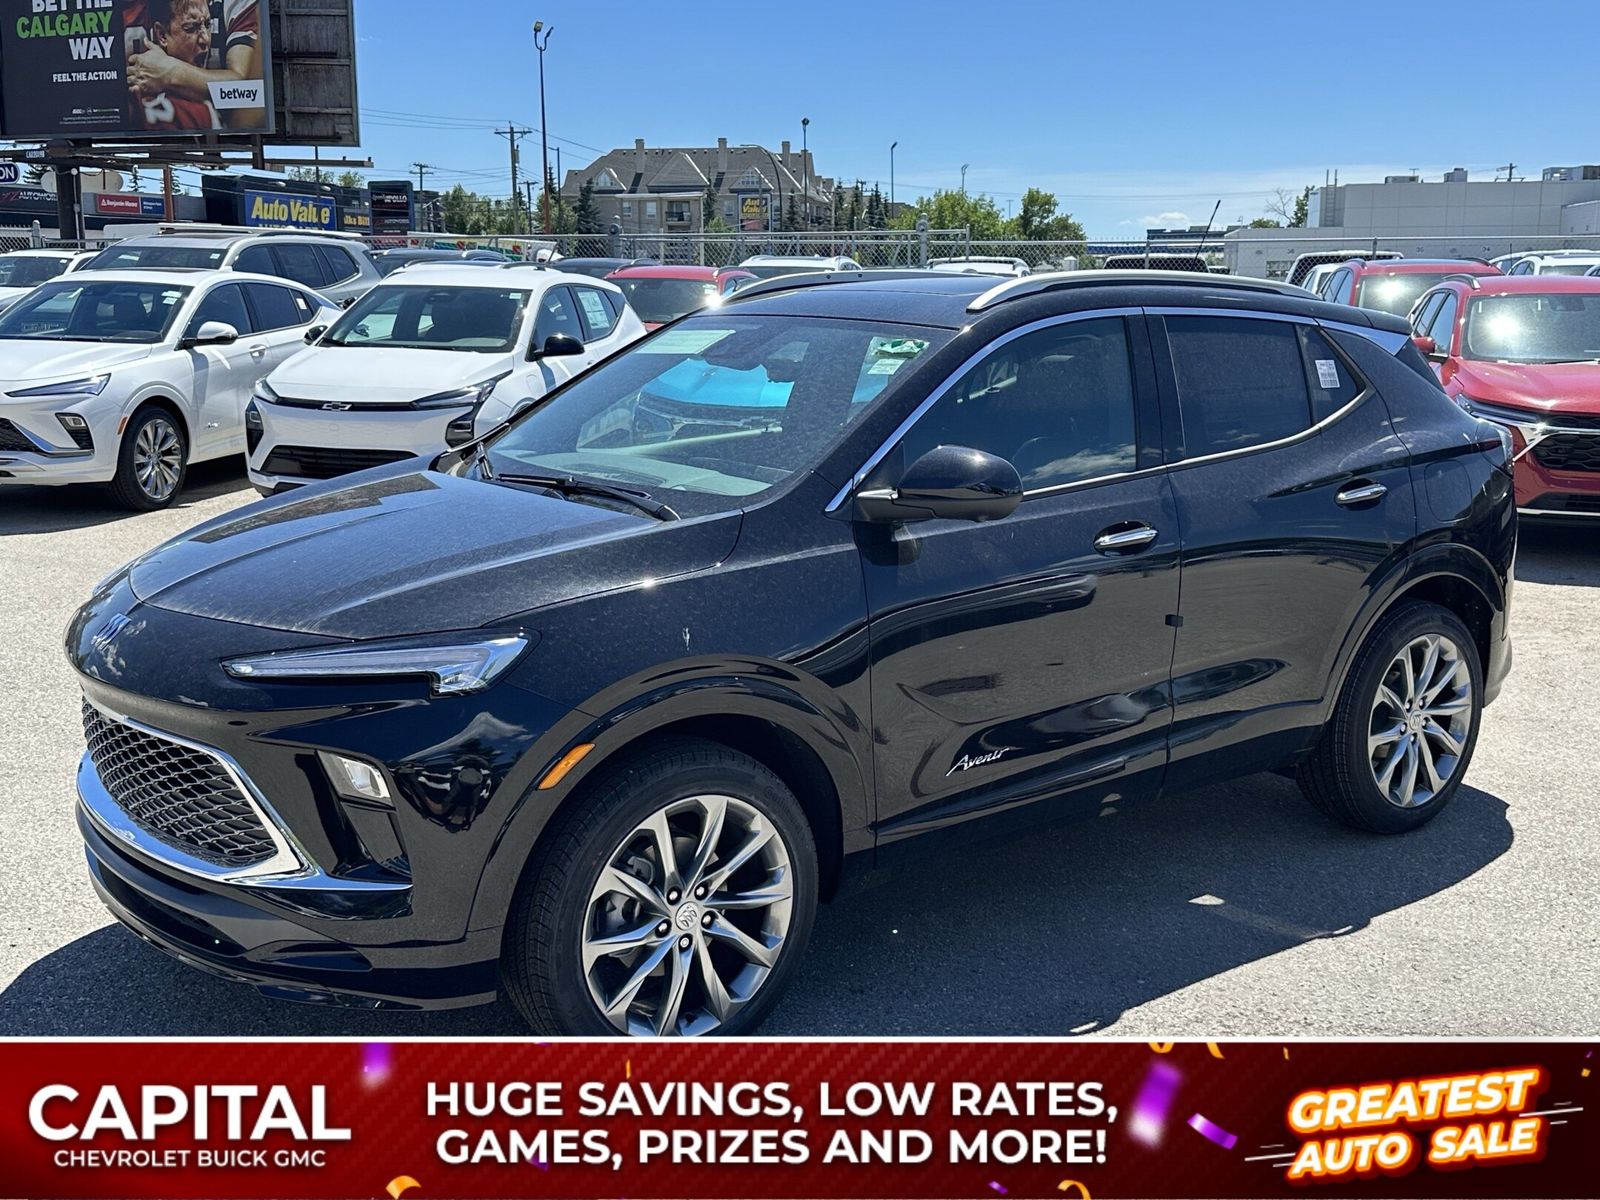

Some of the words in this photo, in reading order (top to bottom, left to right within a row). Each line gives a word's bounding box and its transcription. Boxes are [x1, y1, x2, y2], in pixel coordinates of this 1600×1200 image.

[16, 11, 113, 38] CALGARY
[69, 36, 115, 60] WAY
[52, 73, 71, 83] FEEL
[71, 72, 87, 81] THE
[88, 70, 118, 80] ACTION
[220, 87, 258, 102] betway
[251, 196, 289, 221] Auto
[289, 199, 331, 225] Value
[945, 747, 1010, 777] Avenir
